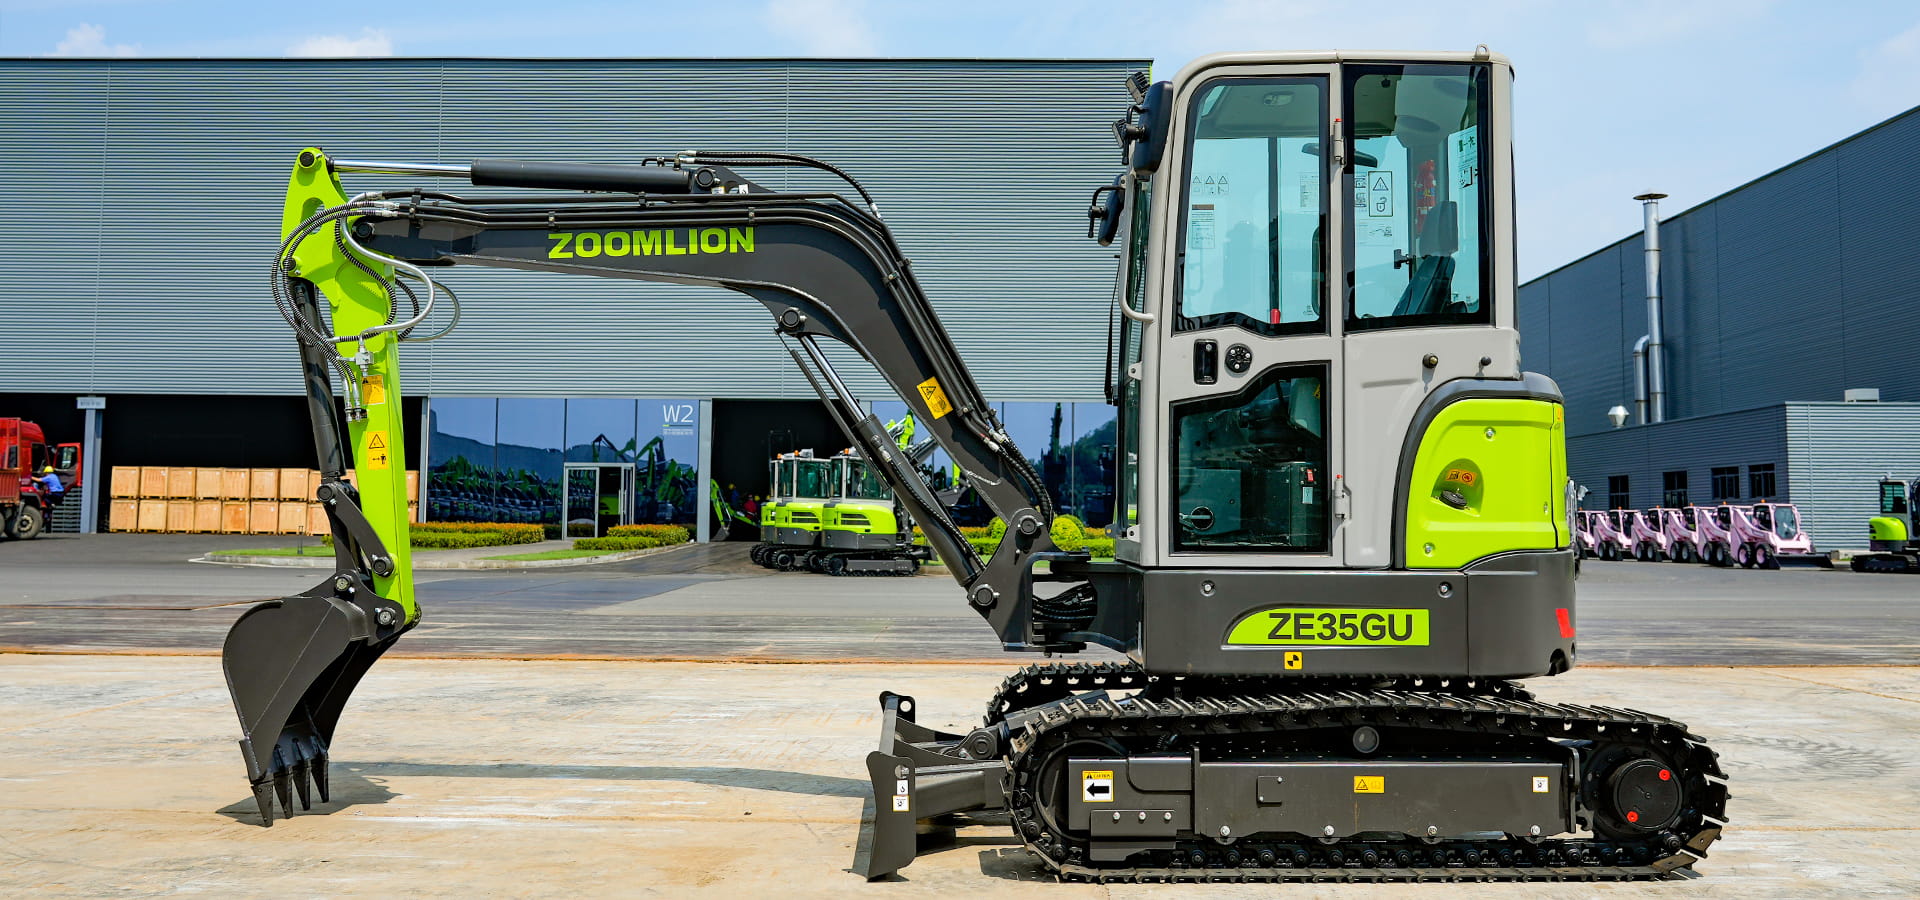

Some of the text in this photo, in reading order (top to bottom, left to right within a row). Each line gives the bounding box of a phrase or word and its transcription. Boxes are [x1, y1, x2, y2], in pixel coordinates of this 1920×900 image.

[548, 227, 755, 258] ZOOMLION
[663, 405, 693, 422] W2
[1267, 613, 1412, 641] ZE35GU
